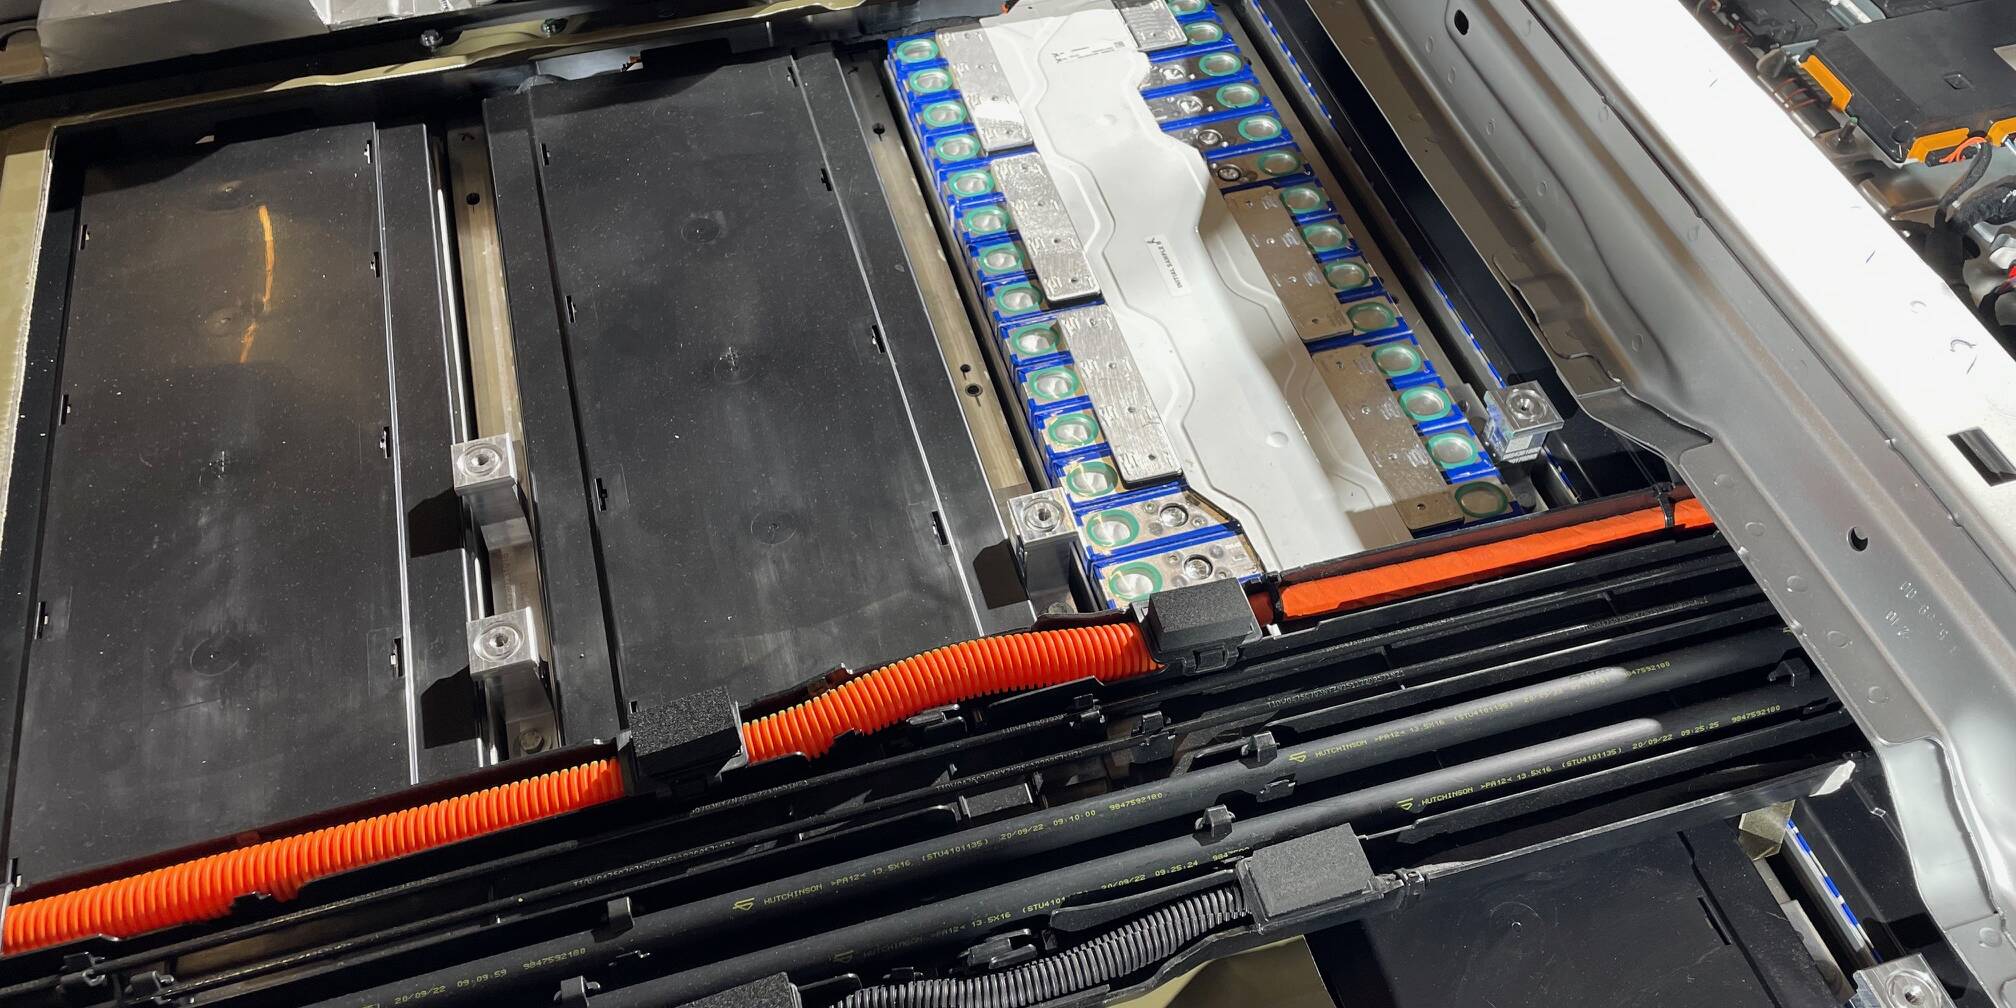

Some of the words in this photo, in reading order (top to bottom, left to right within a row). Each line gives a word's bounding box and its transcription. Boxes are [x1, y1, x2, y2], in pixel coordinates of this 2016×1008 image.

[1315, 739, 1368, 758] HUTCHINSON
[1421, 786, 1474, 806] HUTCHINSON
[1632, 733, 1673, 750] 20/09/22
[1680, 721, 1720, 737] 09:25:25
[763, 883, 824, 905] HUTCHINSON
[1000, 823, 1045, 841] 20/09/22
[1053, 809, 1097, 827] 09:10:00
[971, 911, 1012, 928] 13.5X16
[1154, 859, 1199, 877] 09:25:24
[394, 985, 447, 1005] 20/09/22
